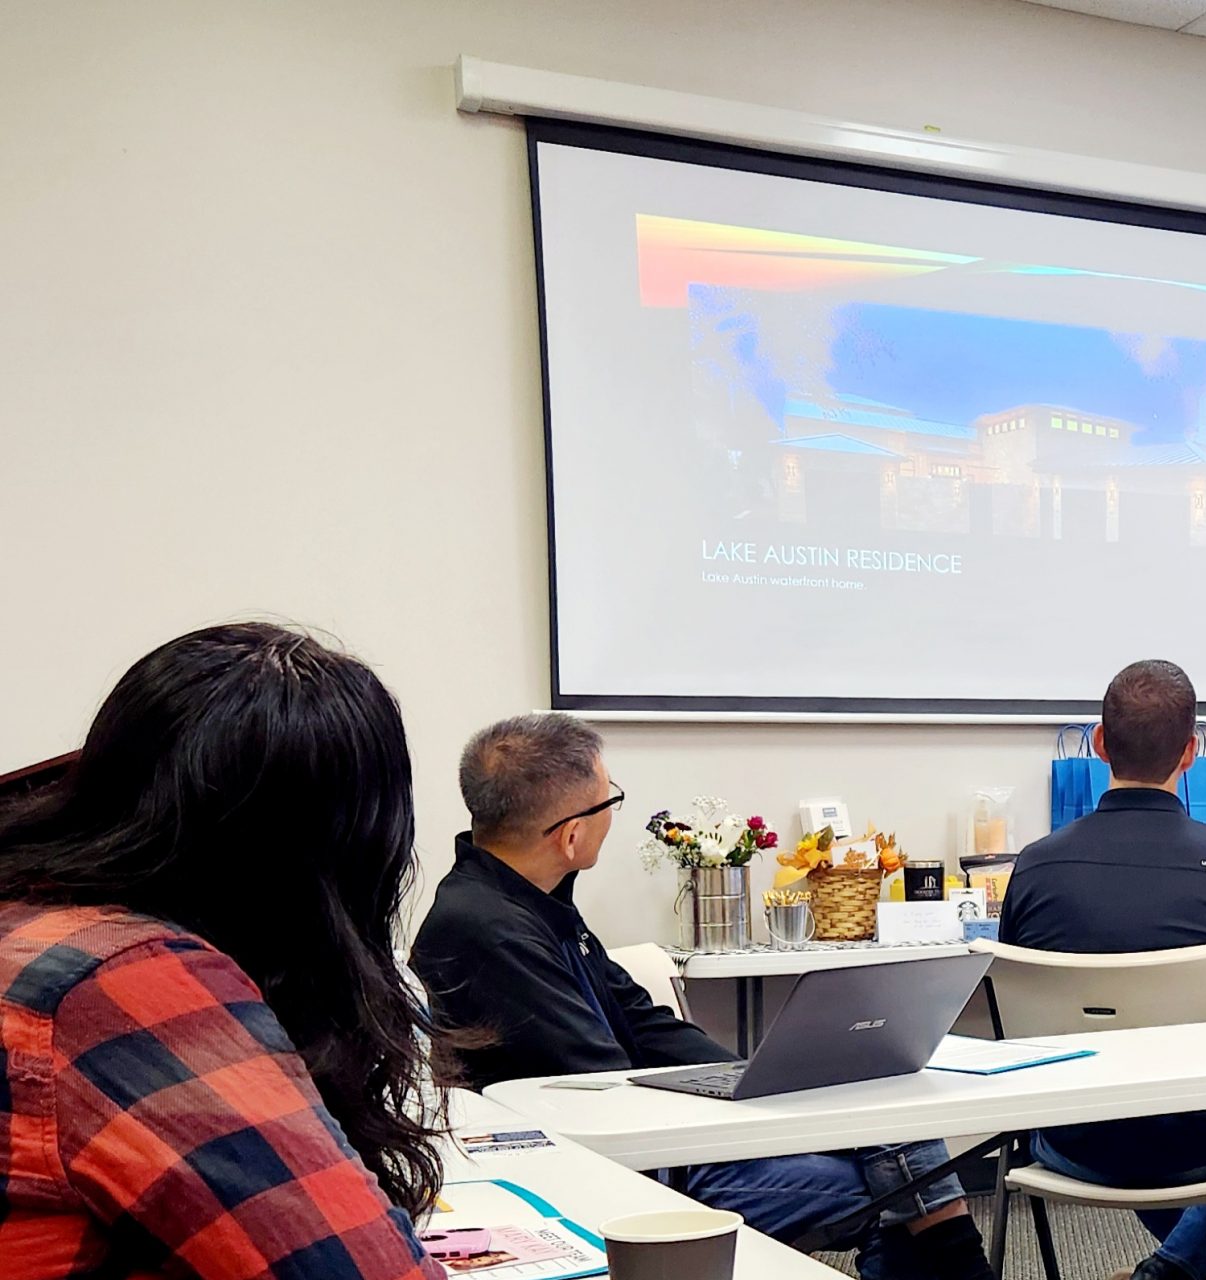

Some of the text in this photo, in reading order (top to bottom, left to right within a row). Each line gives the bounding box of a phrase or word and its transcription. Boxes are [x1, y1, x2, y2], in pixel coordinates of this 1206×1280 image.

[702, 539, 962, 575] LAKE AUSTIN RESIDENCE
[702, 570, 730, 585] Lake
[733, 573, 768, 586] Austin
[770, 575, 830, 590] waterfront
